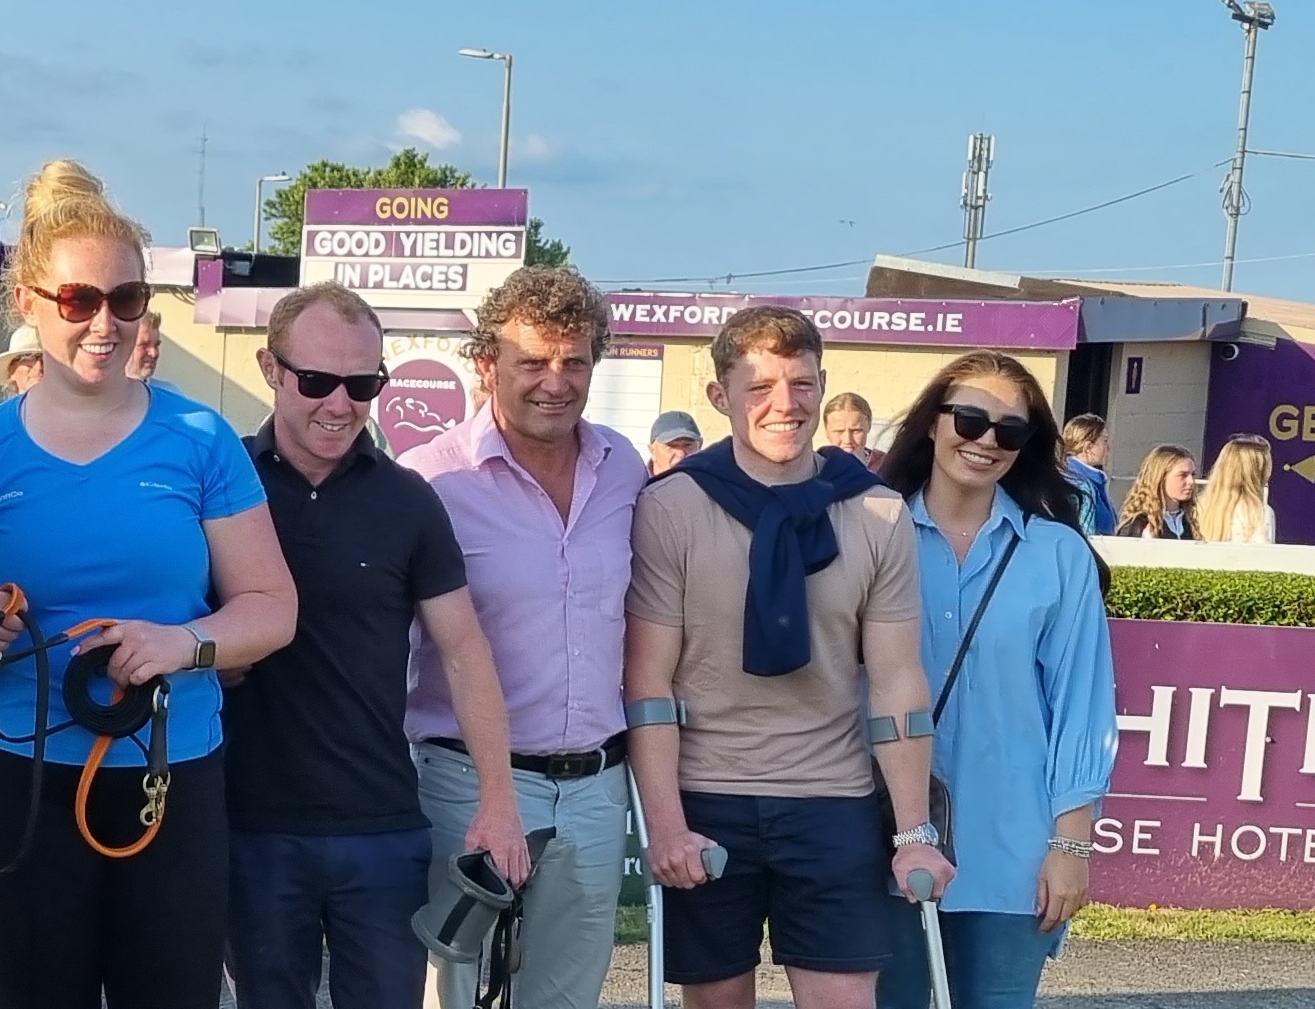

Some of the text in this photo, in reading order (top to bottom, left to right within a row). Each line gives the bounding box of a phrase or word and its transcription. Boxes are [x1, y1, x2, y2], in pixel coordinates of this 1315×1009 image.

[376, 197, 449, 219] GOING
[313, 231, 517, 257] GOOD YIELDING
[337, 263, 464, 290] IN PLACES
[619, 347, 658, 358] RUNNERS
[389, 378, 456, 390] RACECOURSE
[1115, 685, 1315, 802] HIT
[1092, 817, 1162, 856] SE
